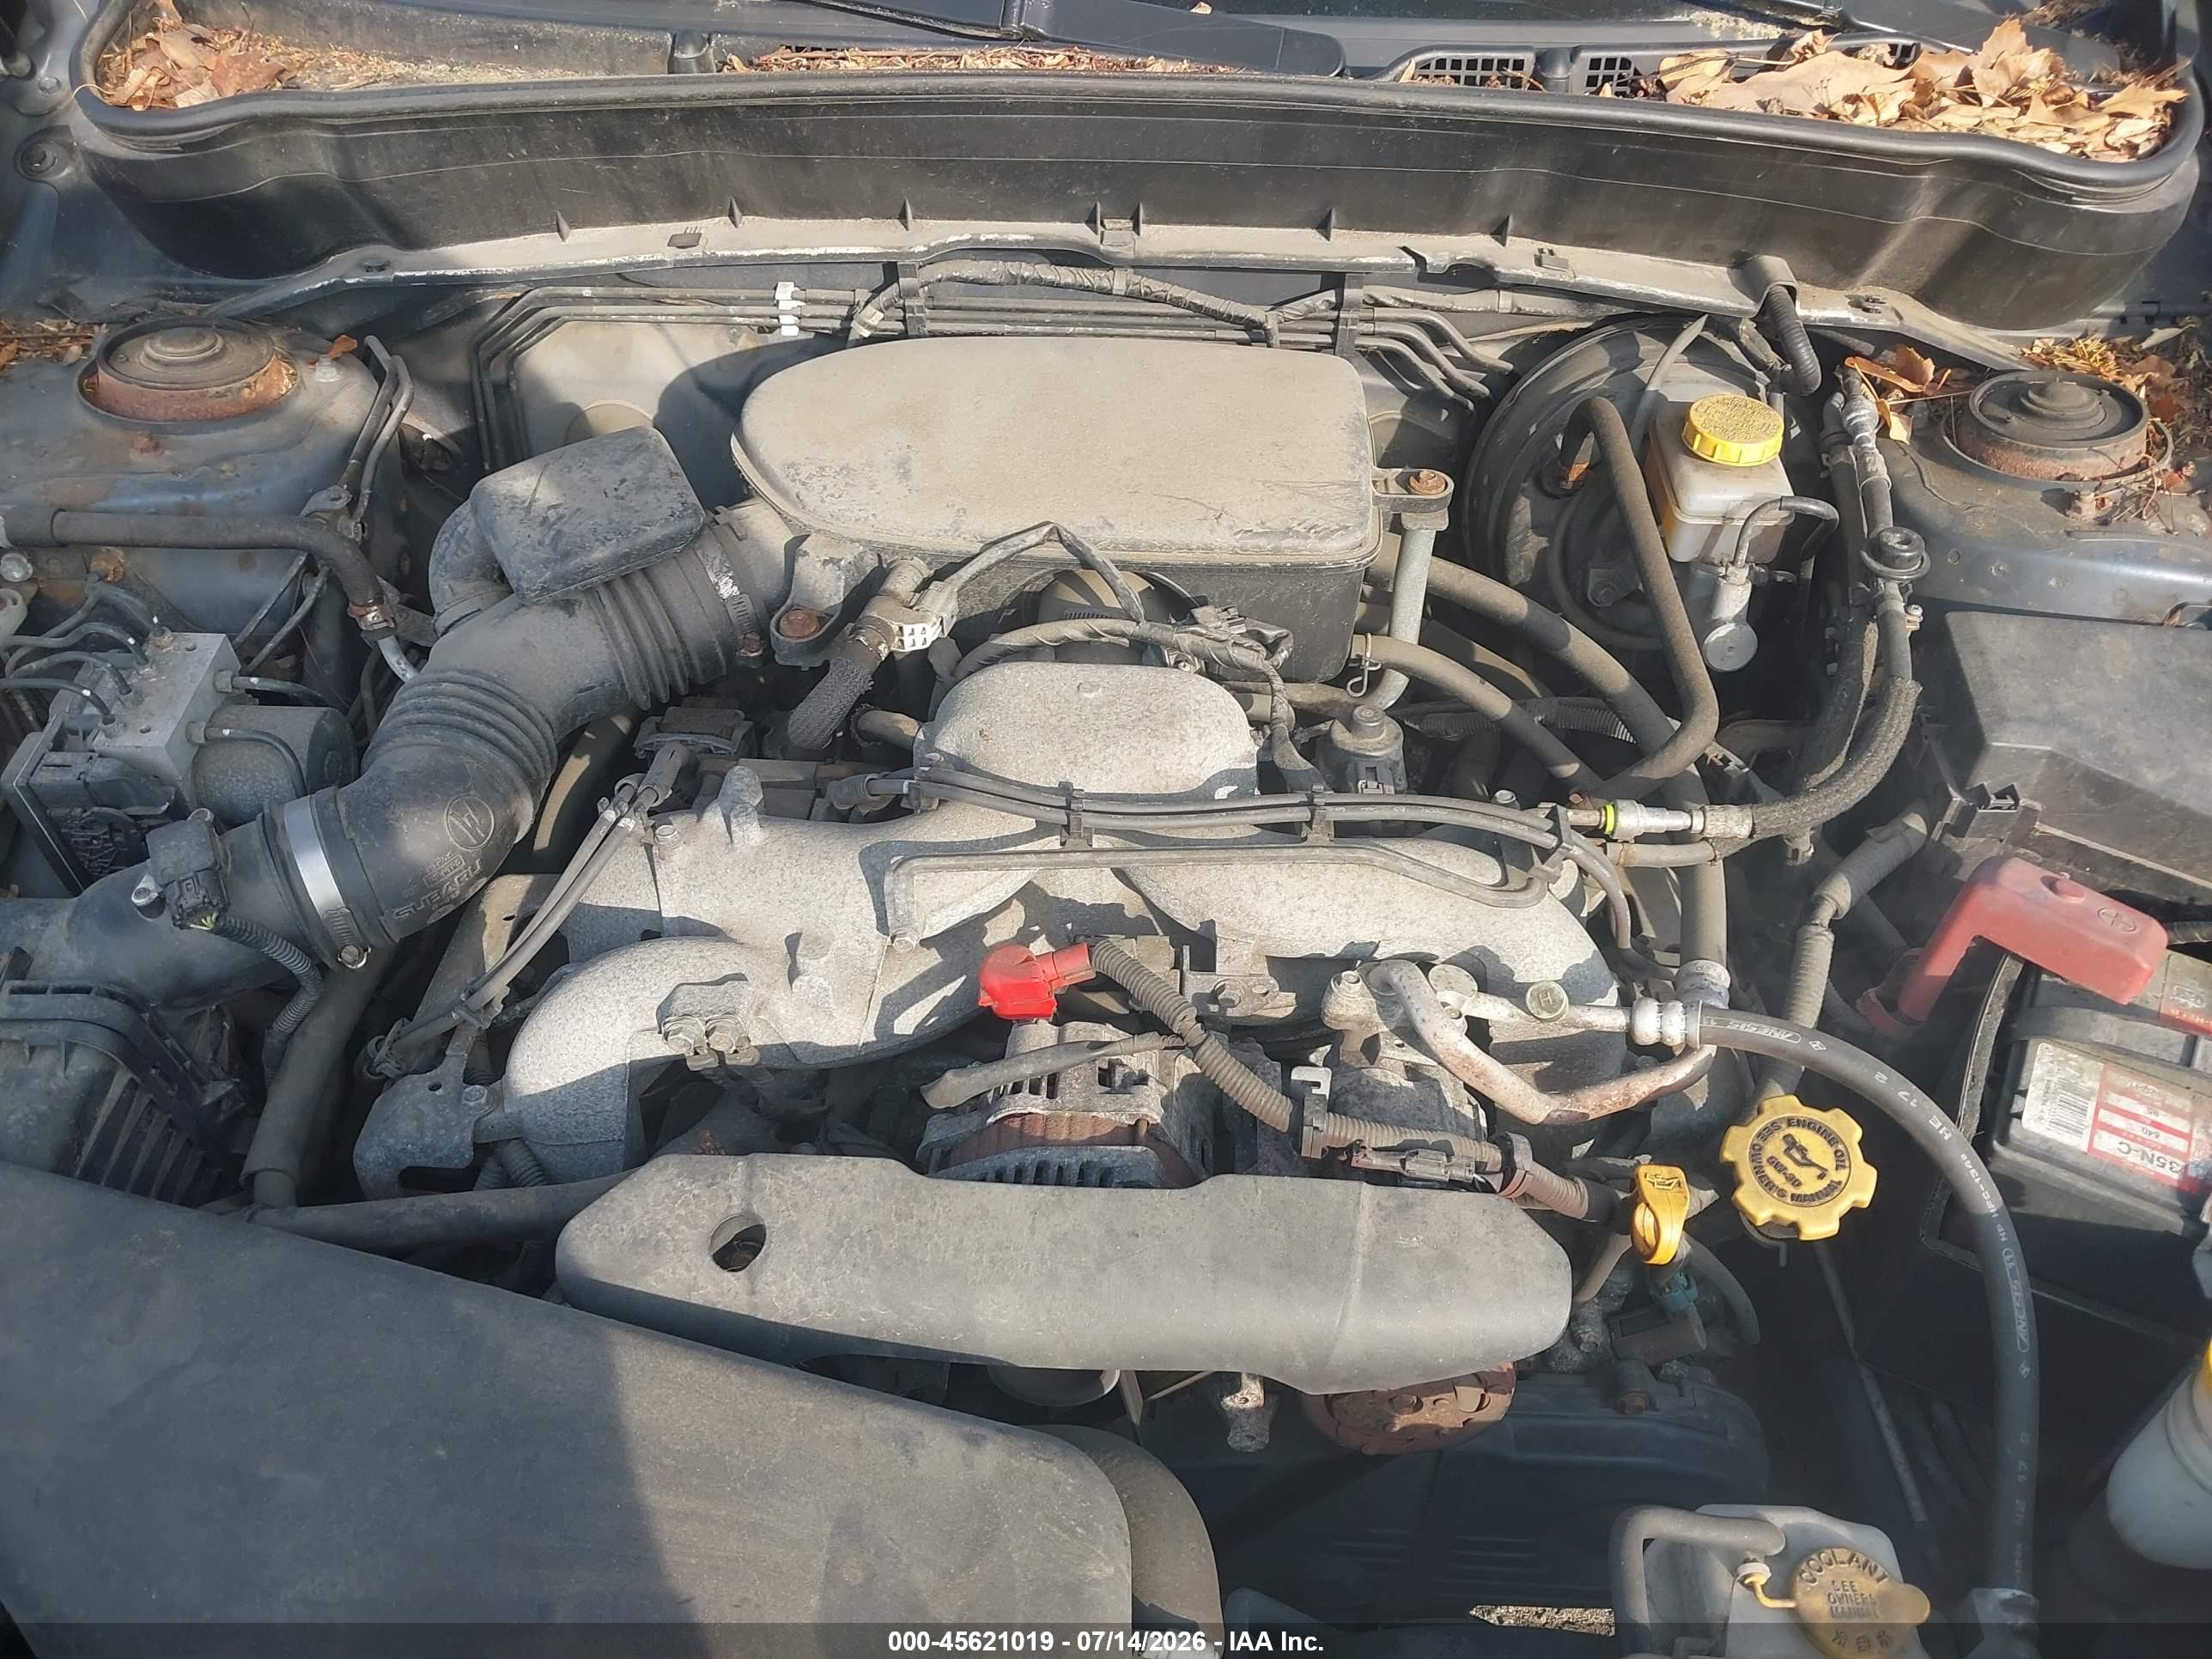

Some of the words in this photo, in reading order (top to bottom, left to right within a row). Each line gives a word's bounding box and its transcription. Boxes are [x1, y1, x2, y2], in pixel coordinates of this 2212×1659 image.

[394, 858, 480, 921] SUBARU
[1538, 990, 1553, 1006] H
[1875, 1071, 1888, 1084] 2
[1897, 1091, 1917, 1108] 17
[1757, 1121, 1784, 1143] SEE
[1929, 1115, 1952, 1140] HE
[2142, 1127, 2160, 1139] 640
[1787, 1118, 1839, 1147] ENGINE
[1833, 1149, 1847, 1171] OIL
[1751, 1143, 1788, 1199] OWNER'S
[1766, 1155, 1802, 1188] 5W-30
[1790, 1179, 1843, 1202] MANUAL
[1800, 1547, 1890, 1586] COOLANT
[1831, 1580, 1857, 1592] SEE
[1828, 1606, 1881, 1620] MANUAL
